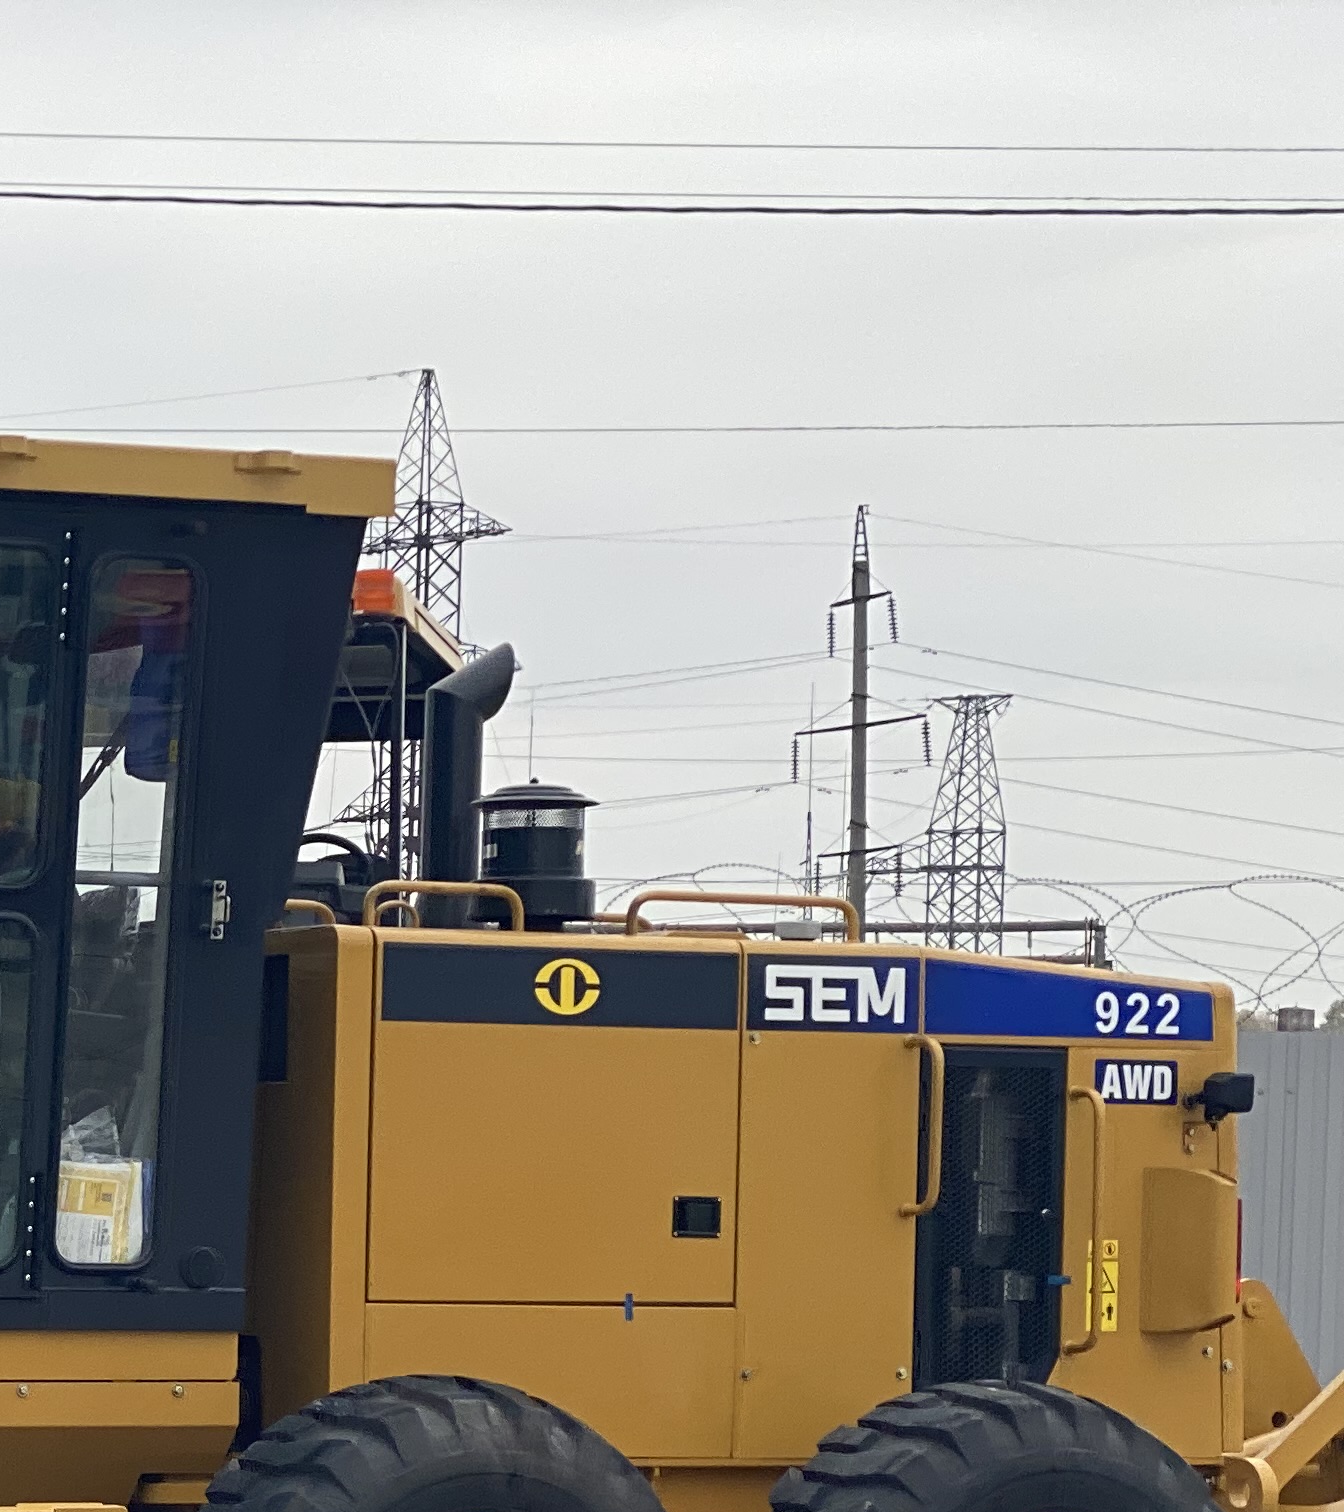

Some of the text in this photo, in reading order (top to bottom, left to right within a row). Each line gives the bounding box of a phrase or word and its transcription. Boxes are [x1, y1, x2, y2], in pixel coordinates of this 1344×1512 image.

[764, 964, 906, 1024] SEM
[1095, 991, 1181, 1036] 922
[1101, 1063, 1173, 1101] AWD
